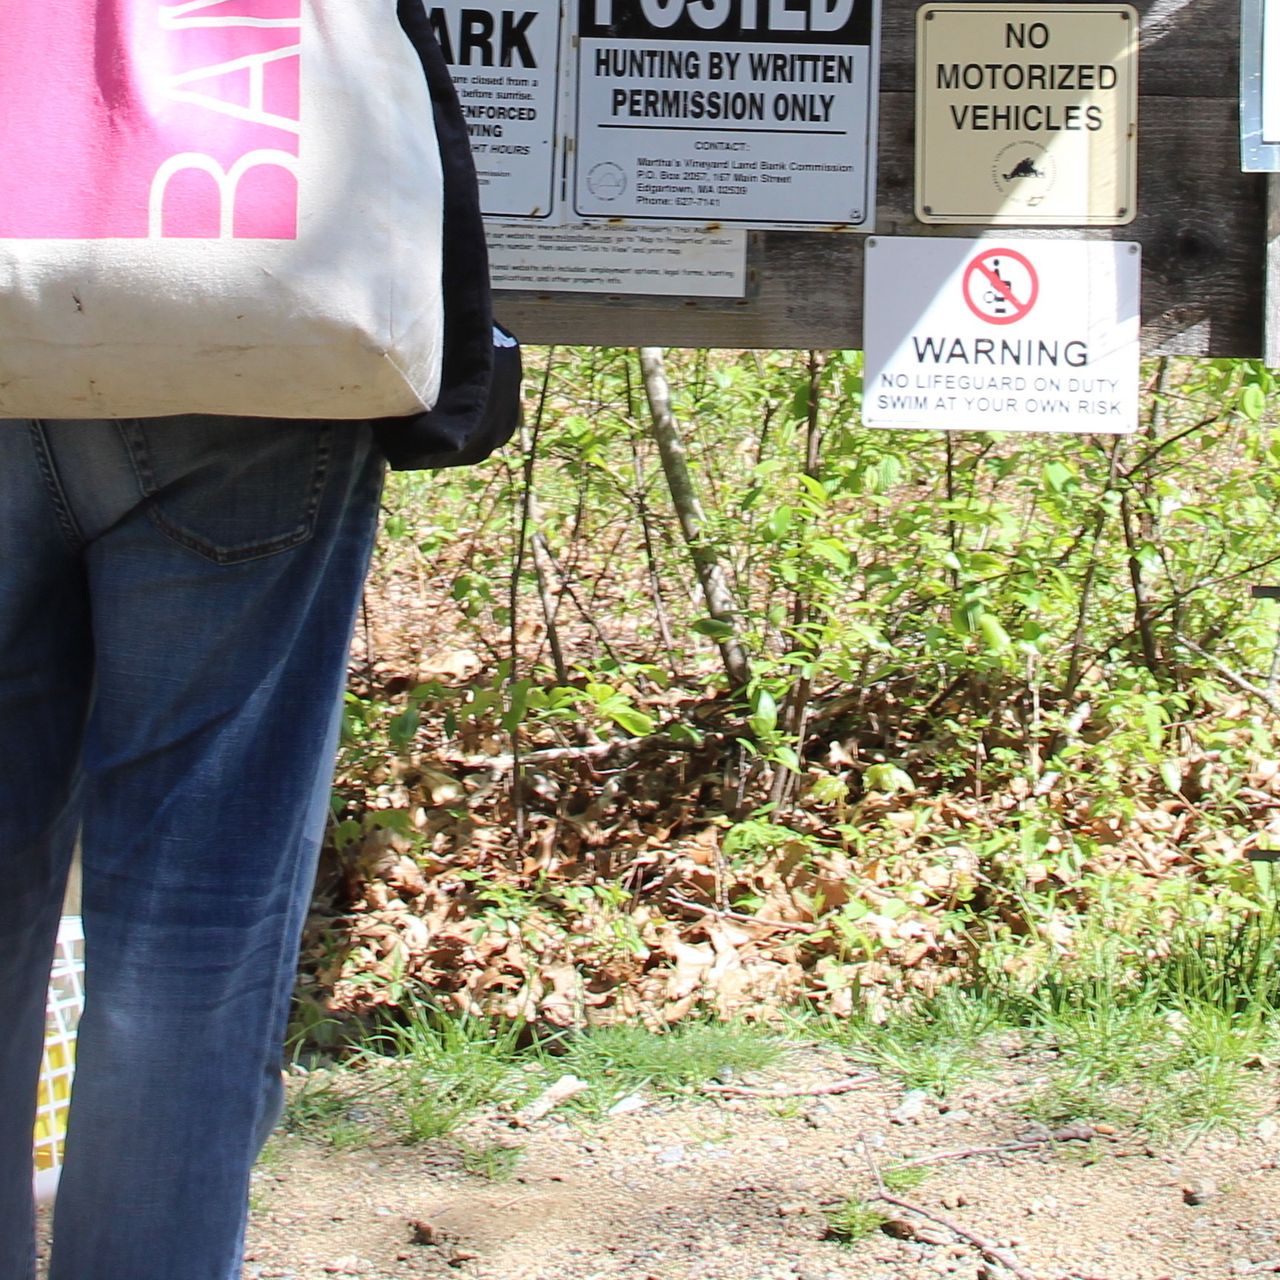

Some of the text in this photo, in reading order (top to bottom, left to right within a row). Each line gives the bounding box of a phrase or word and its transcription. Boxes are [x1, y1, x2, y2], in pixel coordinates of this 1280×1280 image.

[429, 7, 539, 70] ARK
[1006, 22, 1049, 49] NO
[595, 48, 853, 83] HUNTING BY WRITTEN
[937, 63, 1117, 90] MOTORIZED
[471, 75, 504, 86] closed
[506, 76, 529, 87] from
[531, 79, 539, 87] a
[461, 89, 493, 99] before
[611, 88, 835, 122] PERMISSION ONLY
[950, 105, 1103, 131] VEHICLES
[489, 144, 531, 156] HOURS
[637, 157, 855, 172] Martha's Vineyard Land Bank Commission
[660, 170, 681, 180] Box
[733, 173, 759, 182] Main
[761, 173, 792, 184] Street
[912, 336, 1089, 367] WARNING
[881, 374, 1119, 392] NO LIFEGUARD ON DUTY
[877, 395, 1121, 414] SWIM AT YOUR OWN RISK
